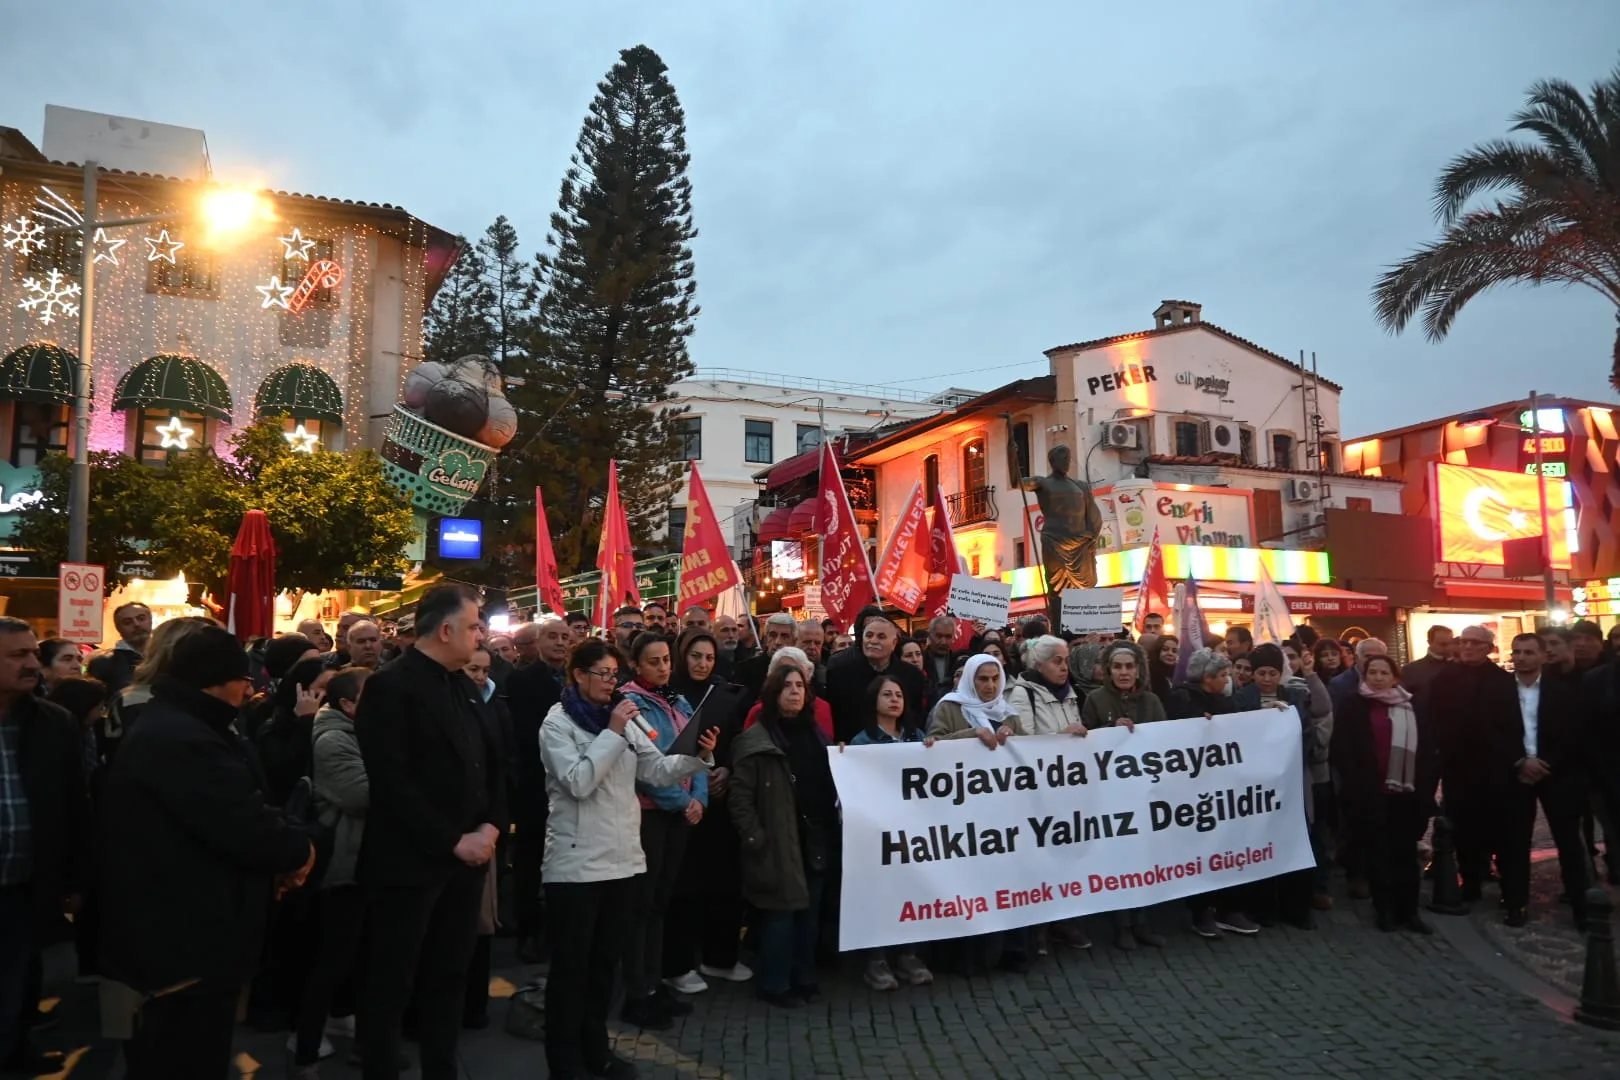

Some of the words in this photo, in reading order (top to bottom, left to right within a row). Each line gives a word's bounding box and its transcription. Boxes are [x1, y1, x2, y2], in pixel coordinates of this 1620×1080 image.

[1087, 365, 1158, 396] PEKER
[902, 754, 1087, 804] Rojava'da
[1094, 741, 1243, 784] Yaşayan
[881, 822, 1019, 866] Halklar
[1027, 808, 1139, 848] Yalnız
[1150, 784, 1282, 833] Değildir.
[899, 895, 989, 922] Antalya
[996, 881, 1054, 910] Emek
[1059, 880, 1082, 898] ve
[1088, 856, 1202, 893] Demokrosi
[1209, 842, 1273, 871] Güçleri
